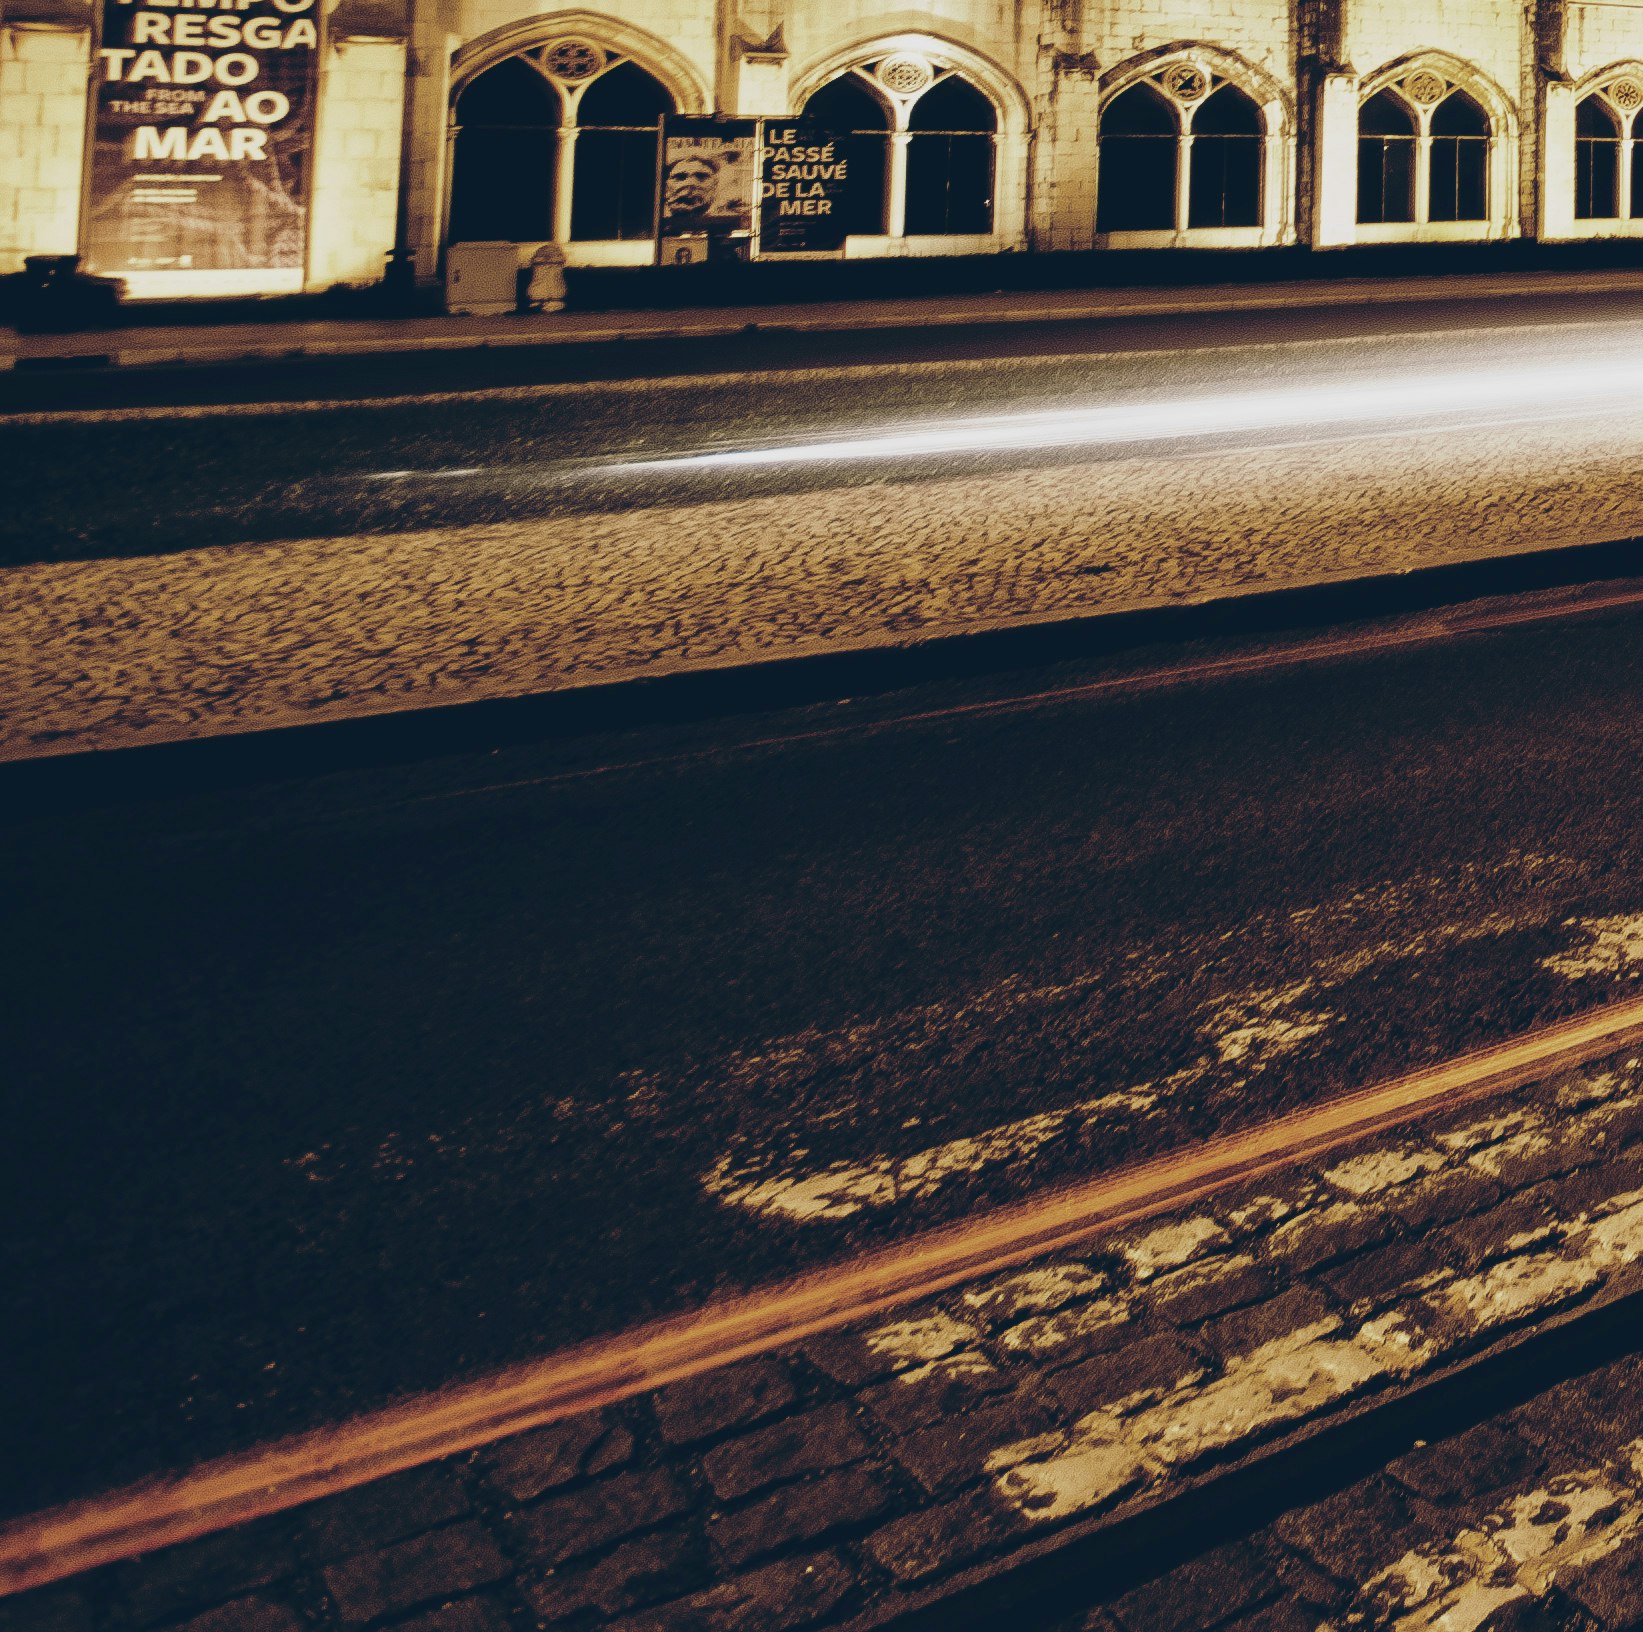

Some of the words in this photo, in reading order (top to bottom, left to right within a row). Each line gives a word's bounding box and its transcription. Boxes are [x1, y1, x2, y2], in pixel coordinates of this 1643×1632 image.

[133, 11, 316, 49] RESGA
[100, 48, 259, 86] TADO
[145, 89, 205, 102] FROM
[202, 90, 290, 124] AO
[132, 125, 268, 160] MAR
[769, 128, 797, 145] LE
[763, 142, 834, 162] PASSÉ
[771, 160, 847, 180] SAUVÉ
[761, 182, 789, 198] DE
[795, 182, 825, 198] LA
[780, 199, 832, 216] MER
